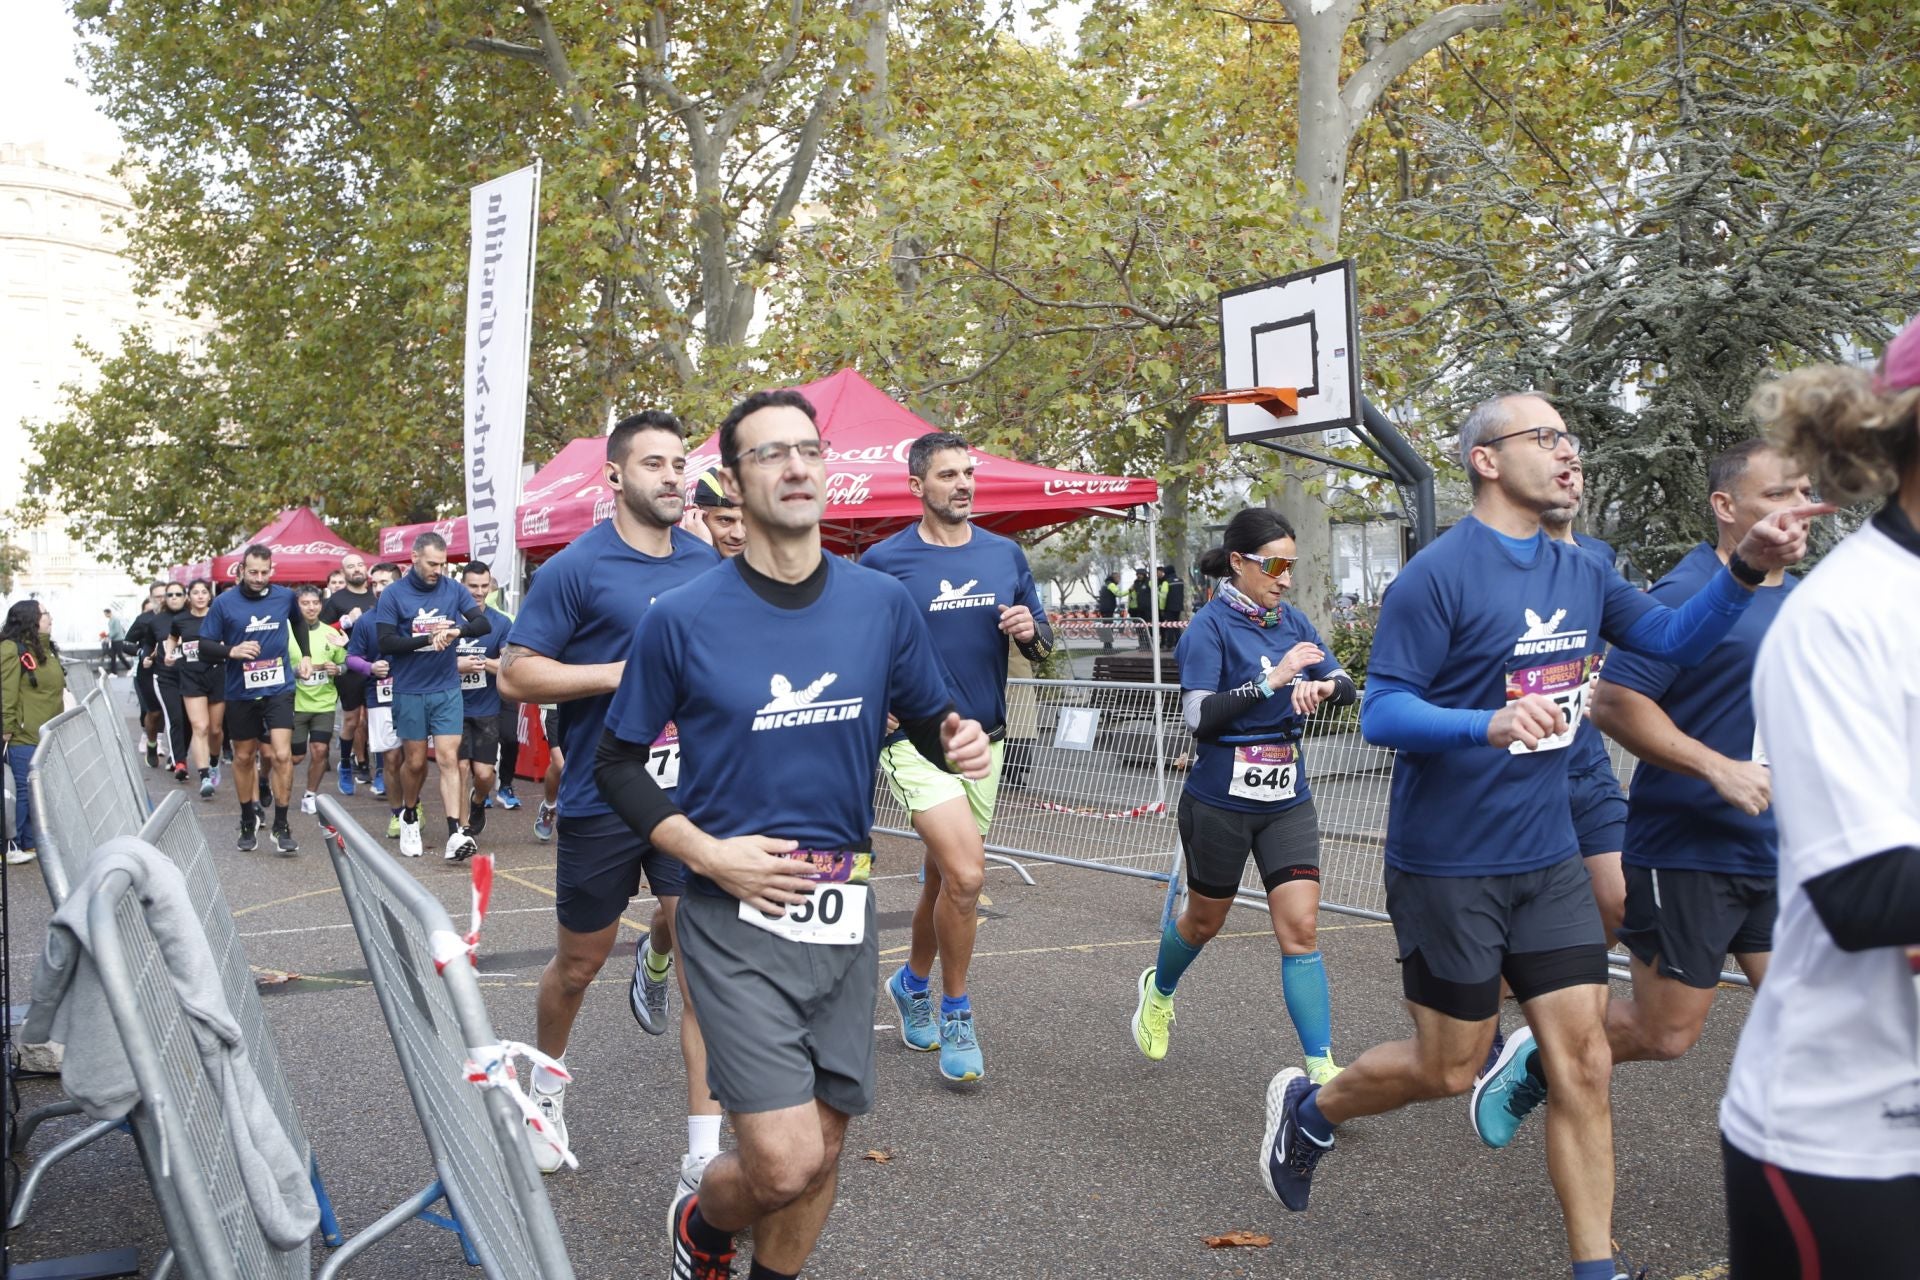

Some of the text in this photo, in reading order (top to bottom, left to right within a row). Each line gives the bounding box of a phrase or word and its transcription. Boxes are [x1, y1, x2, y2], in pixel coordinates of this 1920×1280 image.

[929, 596, 995, 612] MICHELIN
[1513, 636, 1587, 656] MICHELIN
[250, 670, 278, 682] 687
[751, 704, 863, 731] MICHELIN
[1243, 766, 1290, 790] 646
